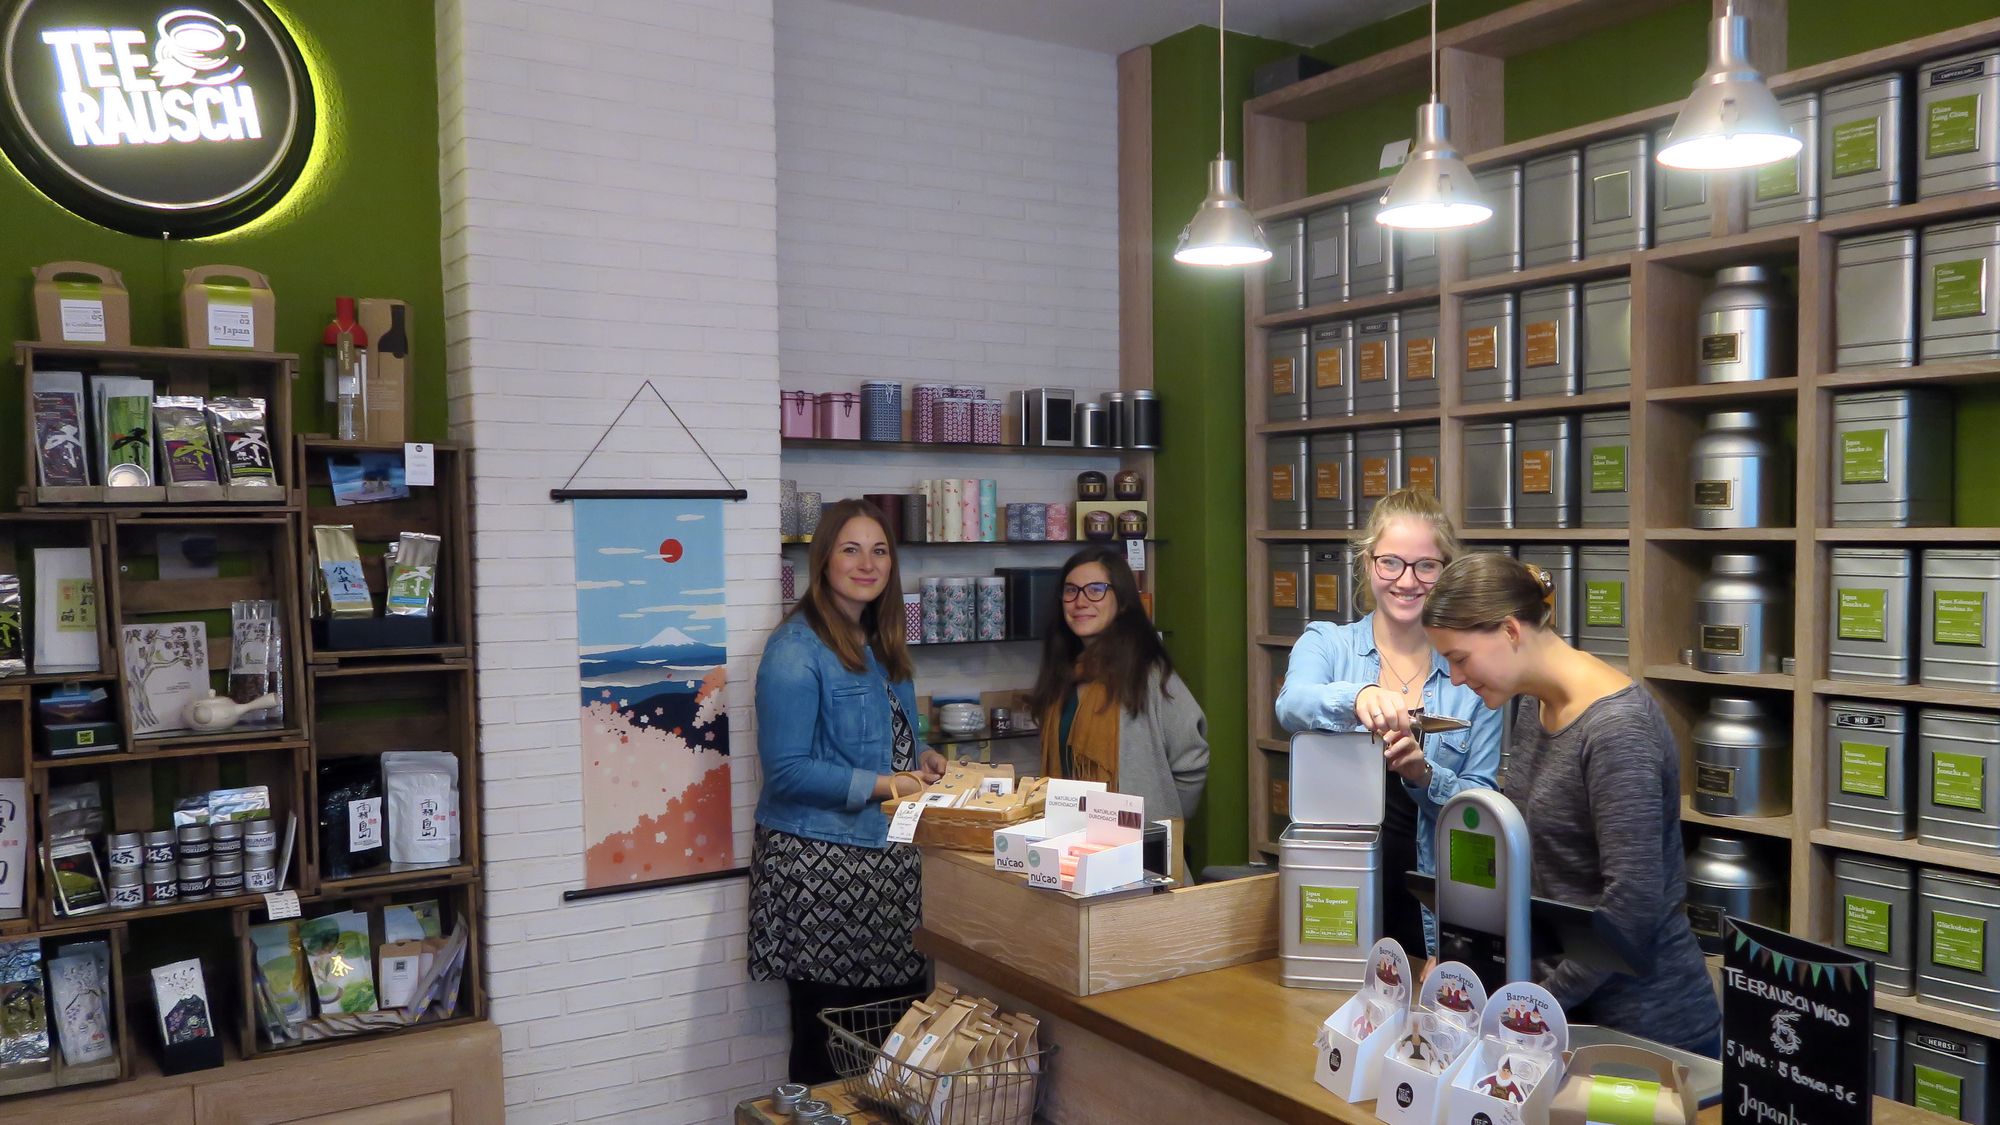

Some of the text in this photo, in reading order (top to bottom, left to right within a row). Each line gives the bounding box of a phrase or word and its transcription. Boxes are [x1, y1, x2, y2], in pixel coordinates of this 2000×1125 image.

[41, 28, 157, 92] TEE
[60, 84, 262, 146] RAUSCH
[223, 325, 250, 336] Japan
[1855, 717, 1869, 725] NEU
[1089, 813, 1117, 822] DURCHDACHT
[1093, 808, 1118, 816] NATÜRLICH
[1379, 946, 1402, 964] Barocktrio
[1440, 971, 1475, 989] Barocktrio
[1506, 992, 1549, 1010] Barocktrio
[1724, 966, 1850, 1027] TEERAUSCH WIRD
[1928, 1038, 1956, 1051] HERBST
[1726, 1039, 1736, 1056] 5
[1738, 1044, 1766, 1068] Jahre
[1778, 1061, 1788, 1077] 5
[1738, 1083, 1808, 1125] Japanb
